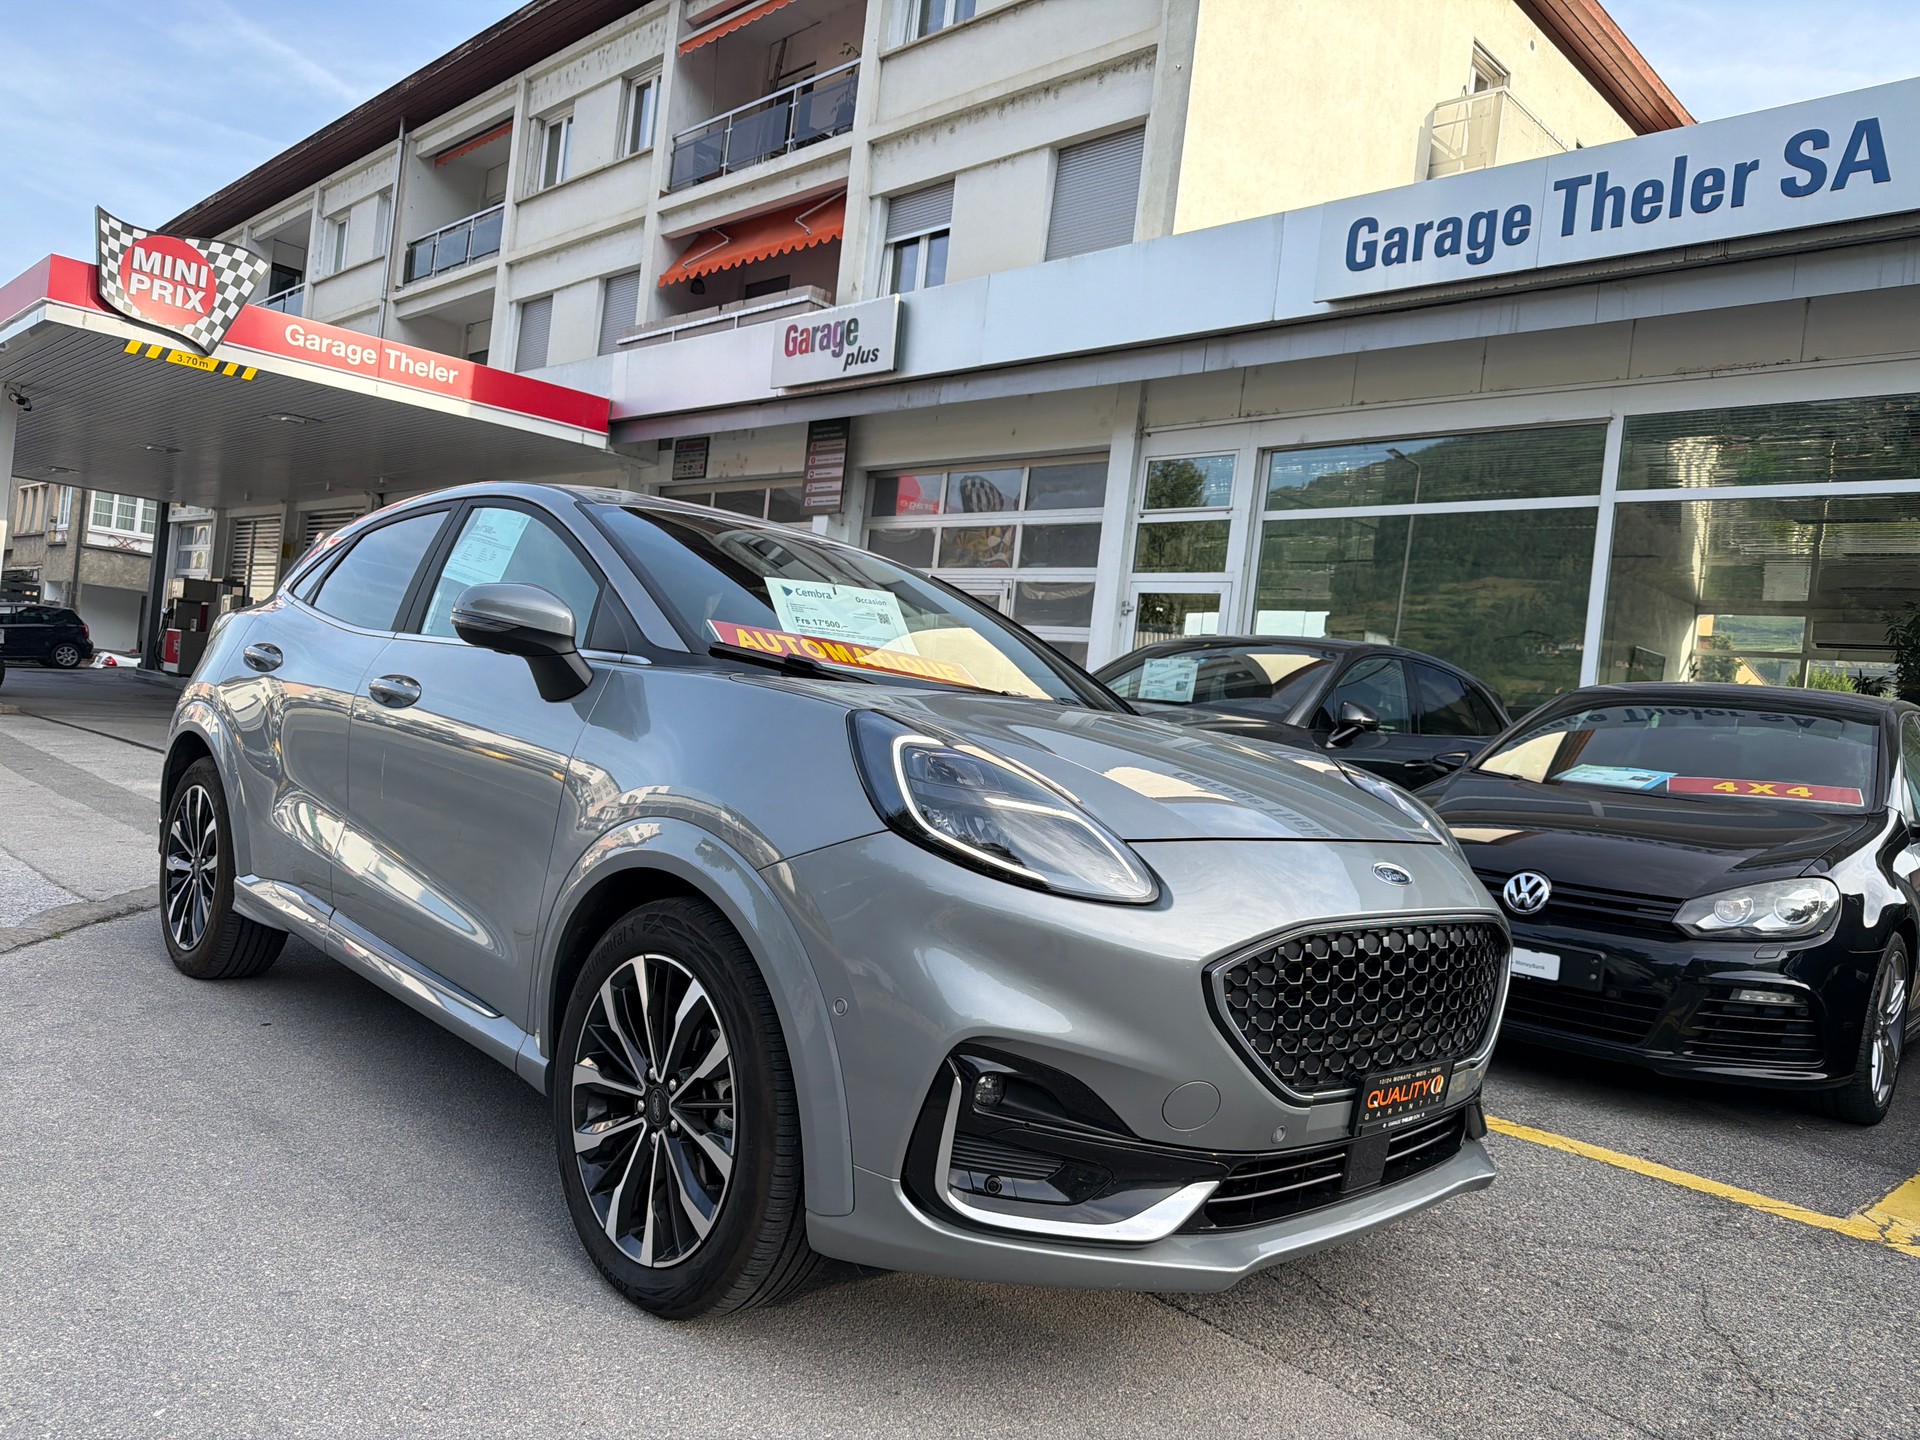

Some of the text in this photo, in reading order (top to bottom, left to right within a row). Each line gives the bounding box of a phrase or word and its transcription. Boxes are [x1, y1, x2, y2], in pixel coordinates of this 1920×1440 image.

[1345, 116, 1892, 273] Garage Theler SA
[131, 245, 209, 289] MINI
[128, 271, 207, 314] PRIX
[284, 323, 459, 385] Garage Theler
[784, 317, 859, 358] Garage
[842, 345, 880, 372] plus
[795, 587, 833, 600] Cembra
[855, 596, 888, 607] Occasion
[795, 616, 811, 626] Frs
[735, 628, 965, 684] AUTOMATIQUE
[1514, 959, 1545, 970] MoneyBank
[1364, 1095, 1440, 1121] GARANTIE
